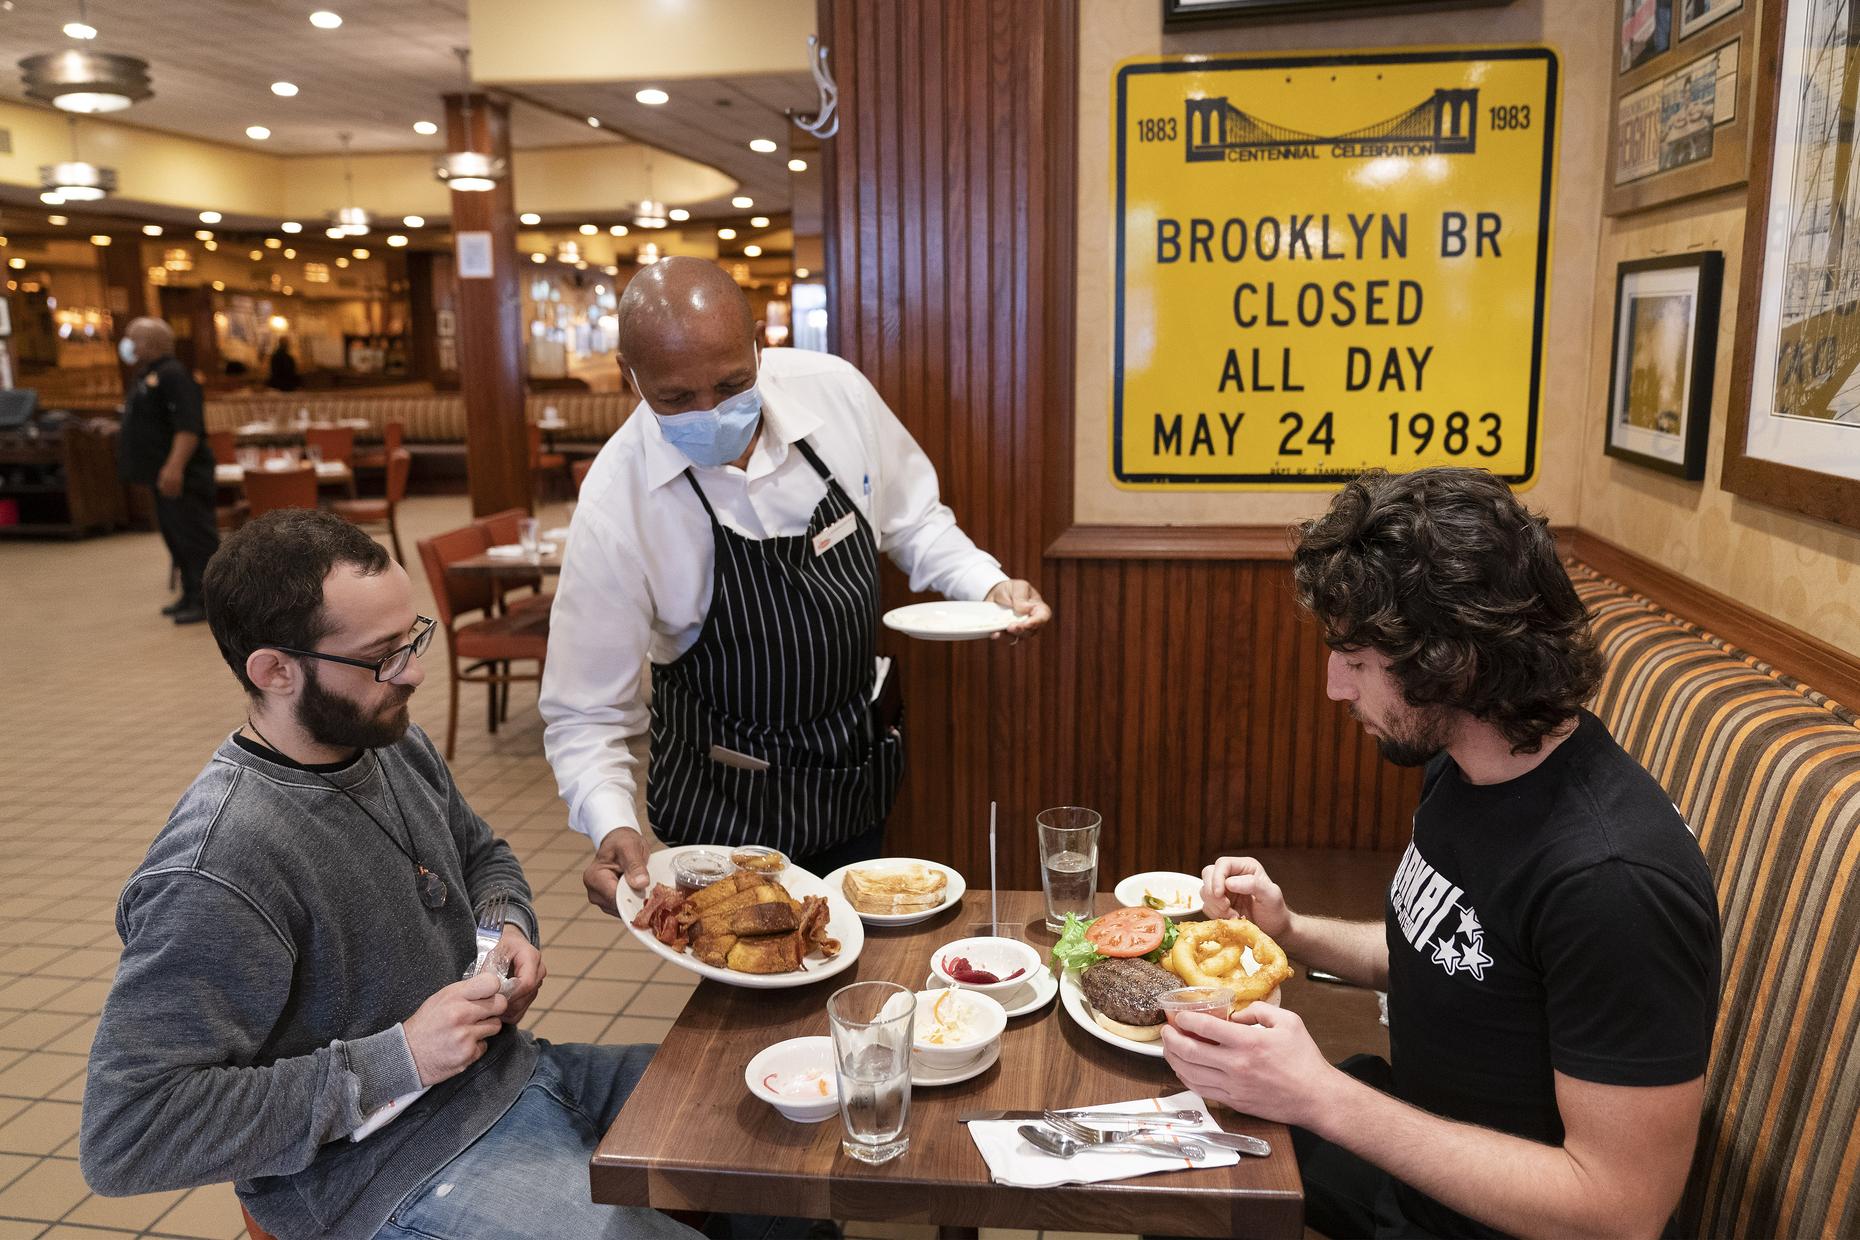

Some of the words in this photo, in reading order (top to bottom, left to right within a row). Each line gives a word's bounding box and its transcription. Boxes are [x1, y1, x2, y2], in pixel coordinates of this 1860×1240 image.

[1137, 117, 1178, 142] 1883
[1488, 105, 1532, 131] 1983
[1227, 147, 1320, 162] CENTENNIAL
[1331, 143, 1433, 159] CELEBRATION
[1156, 213, 1408, 264] BROOKLYN
[1440, 211, 1503, 258] BR
[1233, 280, 1424, 329] CLOSED
[1217, 347, 1305, 393] ALL
[1345, 346, 1434, 393] DAY
[1153, 412, 1246, 457] MAY
[1277, 410, 1336, 456] 24
[1388, 411, 1504, 458] 1983
